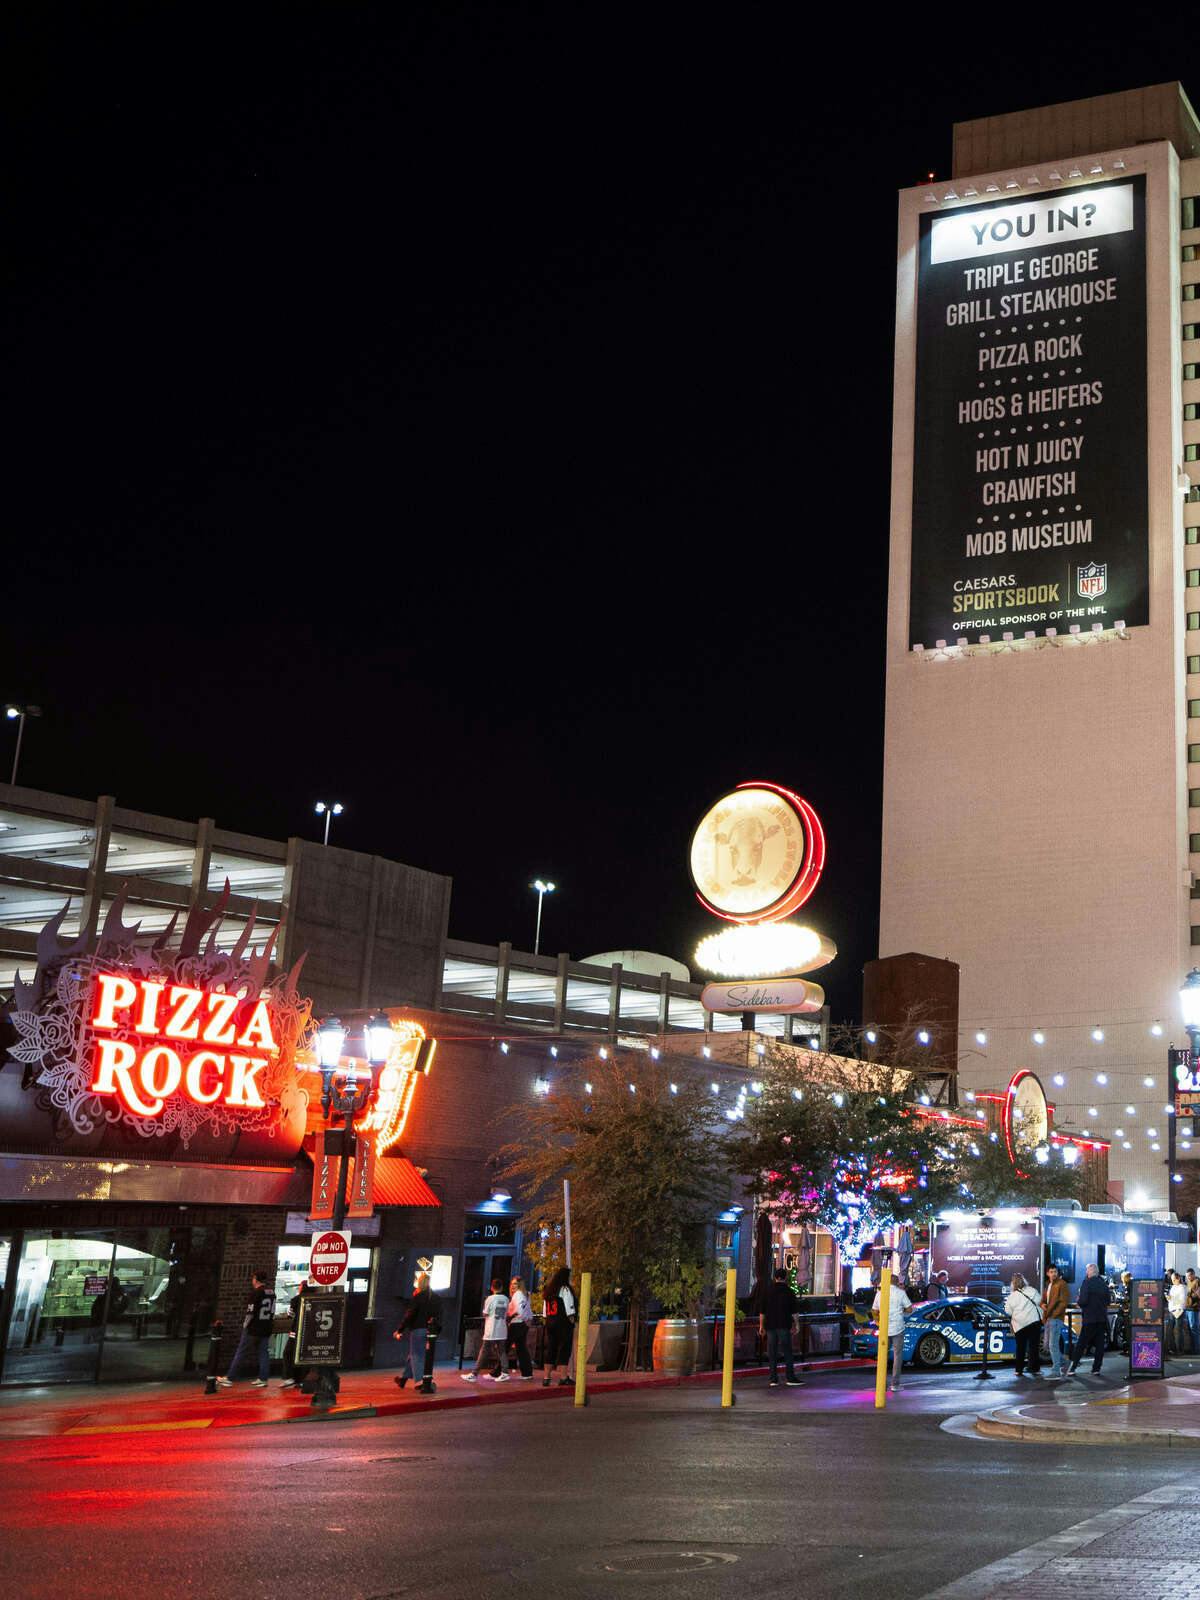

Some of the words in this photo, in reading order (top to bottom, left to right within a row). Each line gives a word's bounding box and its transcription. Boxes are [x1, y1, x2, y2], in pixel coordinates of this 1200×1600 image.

[972, 213, 1036, 245] YOU
[1047, 203, 1096, 233] IN?
[964, 261, 1024, 291] TRIPLE
[1029, 248, 1099, 281] GEORGE
[946, 299, 995, 326] GRILL
[1000, 277, 1117, 318] STEAKHOUSE
[978, 342, 1029, 371] PIZZA
[1034, 334, 1082, 363] ROCK
[958, 396, 1005, 424] HOGS
[1011, 393, 1023, 416] &
[1028, 381, 1103, 413] HEIFERS
[976, 446, 1011, 472] HOT
[1017, 444, 1029, 467] N
[1034, 435, 1084, 465] JUICY
[983, 471, 1076, 505] CRAWFISH
[966, 530, 1006, 557] MOB
[1012, 519, 1092, 552] MUSEUM
[953, 574, 1016, 592] CAESARS
[953, 584, 1060, 613] SPORTSBOOK
[1080, 578, 1103, 594] NFL
[952, 618, 997, 631] OFFICIAL
[1000, 613, 1046, 625] SPONSOR
[1049, 609, 1063, 620] OF
[1066, 607, 1085, 617] THE
[1088, 605, 1107, 615] NFL
[93, 974, 280, 1050] PIZZA
[726, 986, 784, 1009] Sidebar
[92, 1039, 269, 1116] ROCK
[320, 1155, 329, 1199] IZZA
[360, 1140, 370, 1197] SLICES
[317, 1242, 328, 1251] DO
[330, 1242, 344, 1251] NOT
[485, 1225, 498, 1237] 120
[316, 1265, 339, 1275] ENTER
[315, 1310, 333, 1330] $5
[941, 1327, 974, 1349] GROUP
